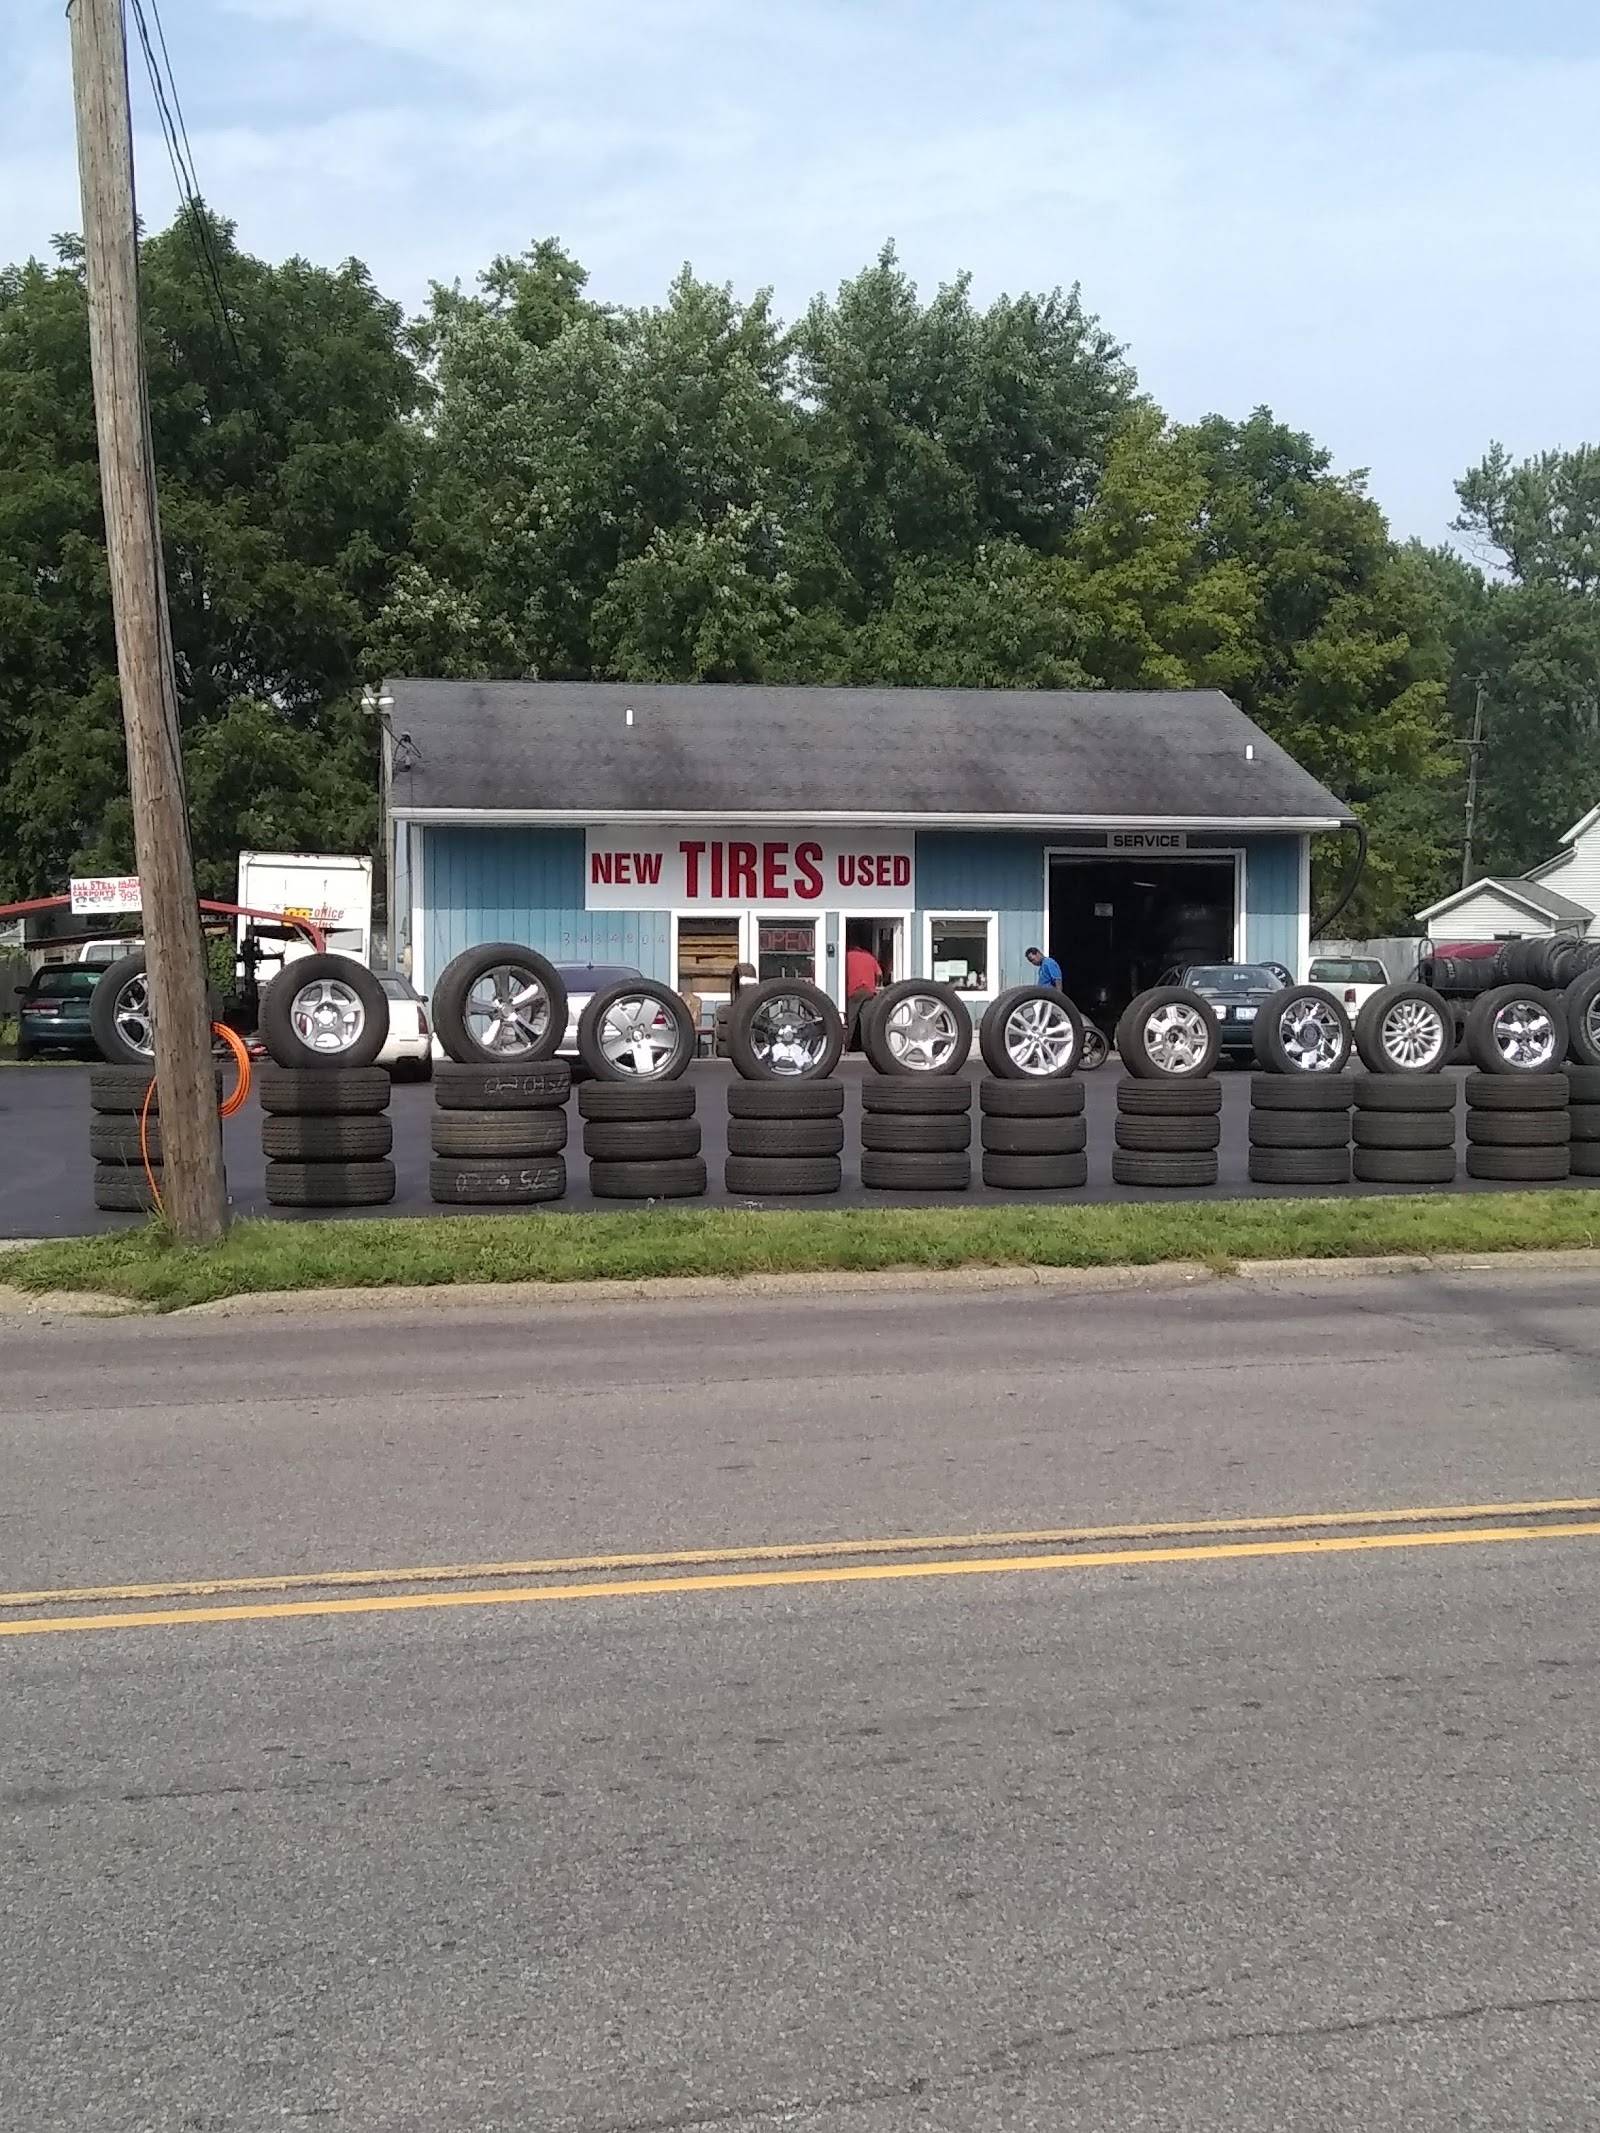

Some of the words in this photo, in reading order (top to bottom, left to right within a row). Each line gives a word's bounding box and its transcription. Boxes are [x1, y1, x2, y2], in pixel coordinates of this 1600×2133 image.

[1113, 834, 1180, 848] SERVICE
[591, 852, 663, 884] NEW
[679, 840, 824, 900] TIRES
[838, 854, 911, 886] USED
[759, 931, 812, 951] OPEN
